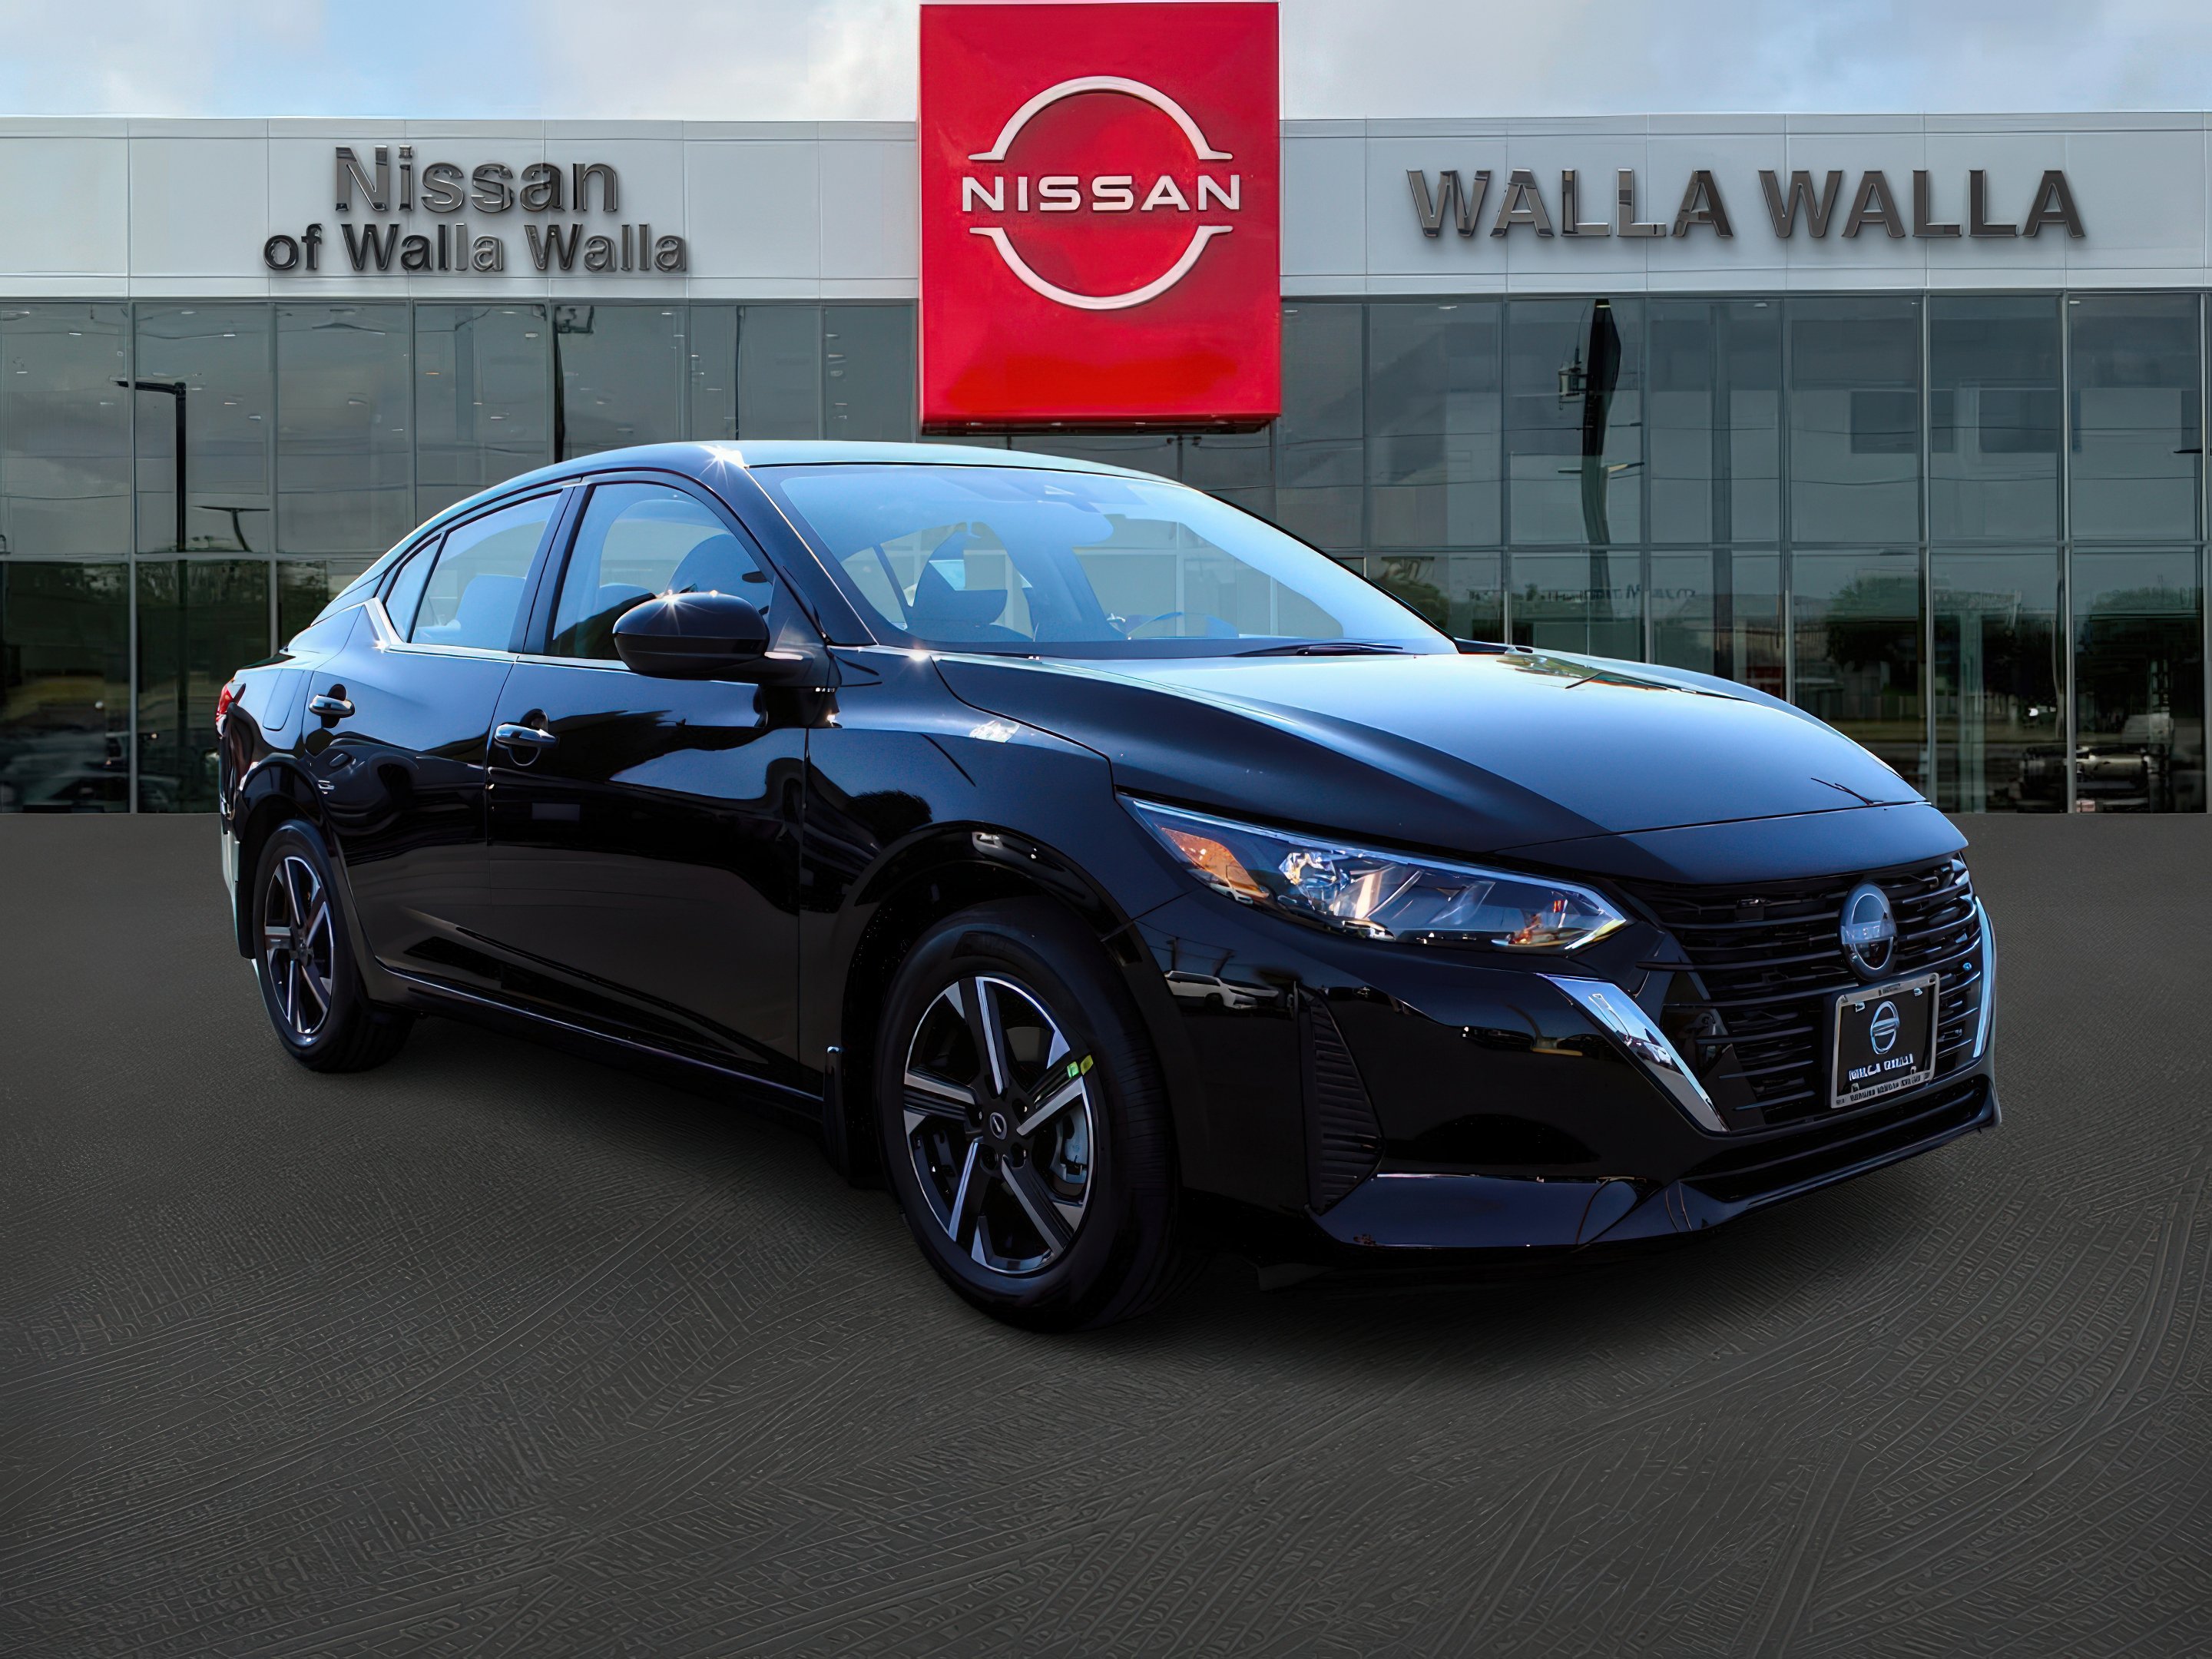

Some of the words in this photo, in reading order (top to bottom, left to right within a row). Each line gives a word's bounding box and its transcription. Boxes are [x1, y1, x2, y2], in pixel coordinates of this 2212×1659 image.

[335, 144, 618, 212] Nissan
[962, 174, 1240, 211] NISSAN
[1406, 168, 1734, 238] WALLA
[1757, 169, 2086, 238] WALLA
[264, 223, 323, 270] of
[340, 223, 504, 272] Walla
[524, 223, 687, 272] Walla
